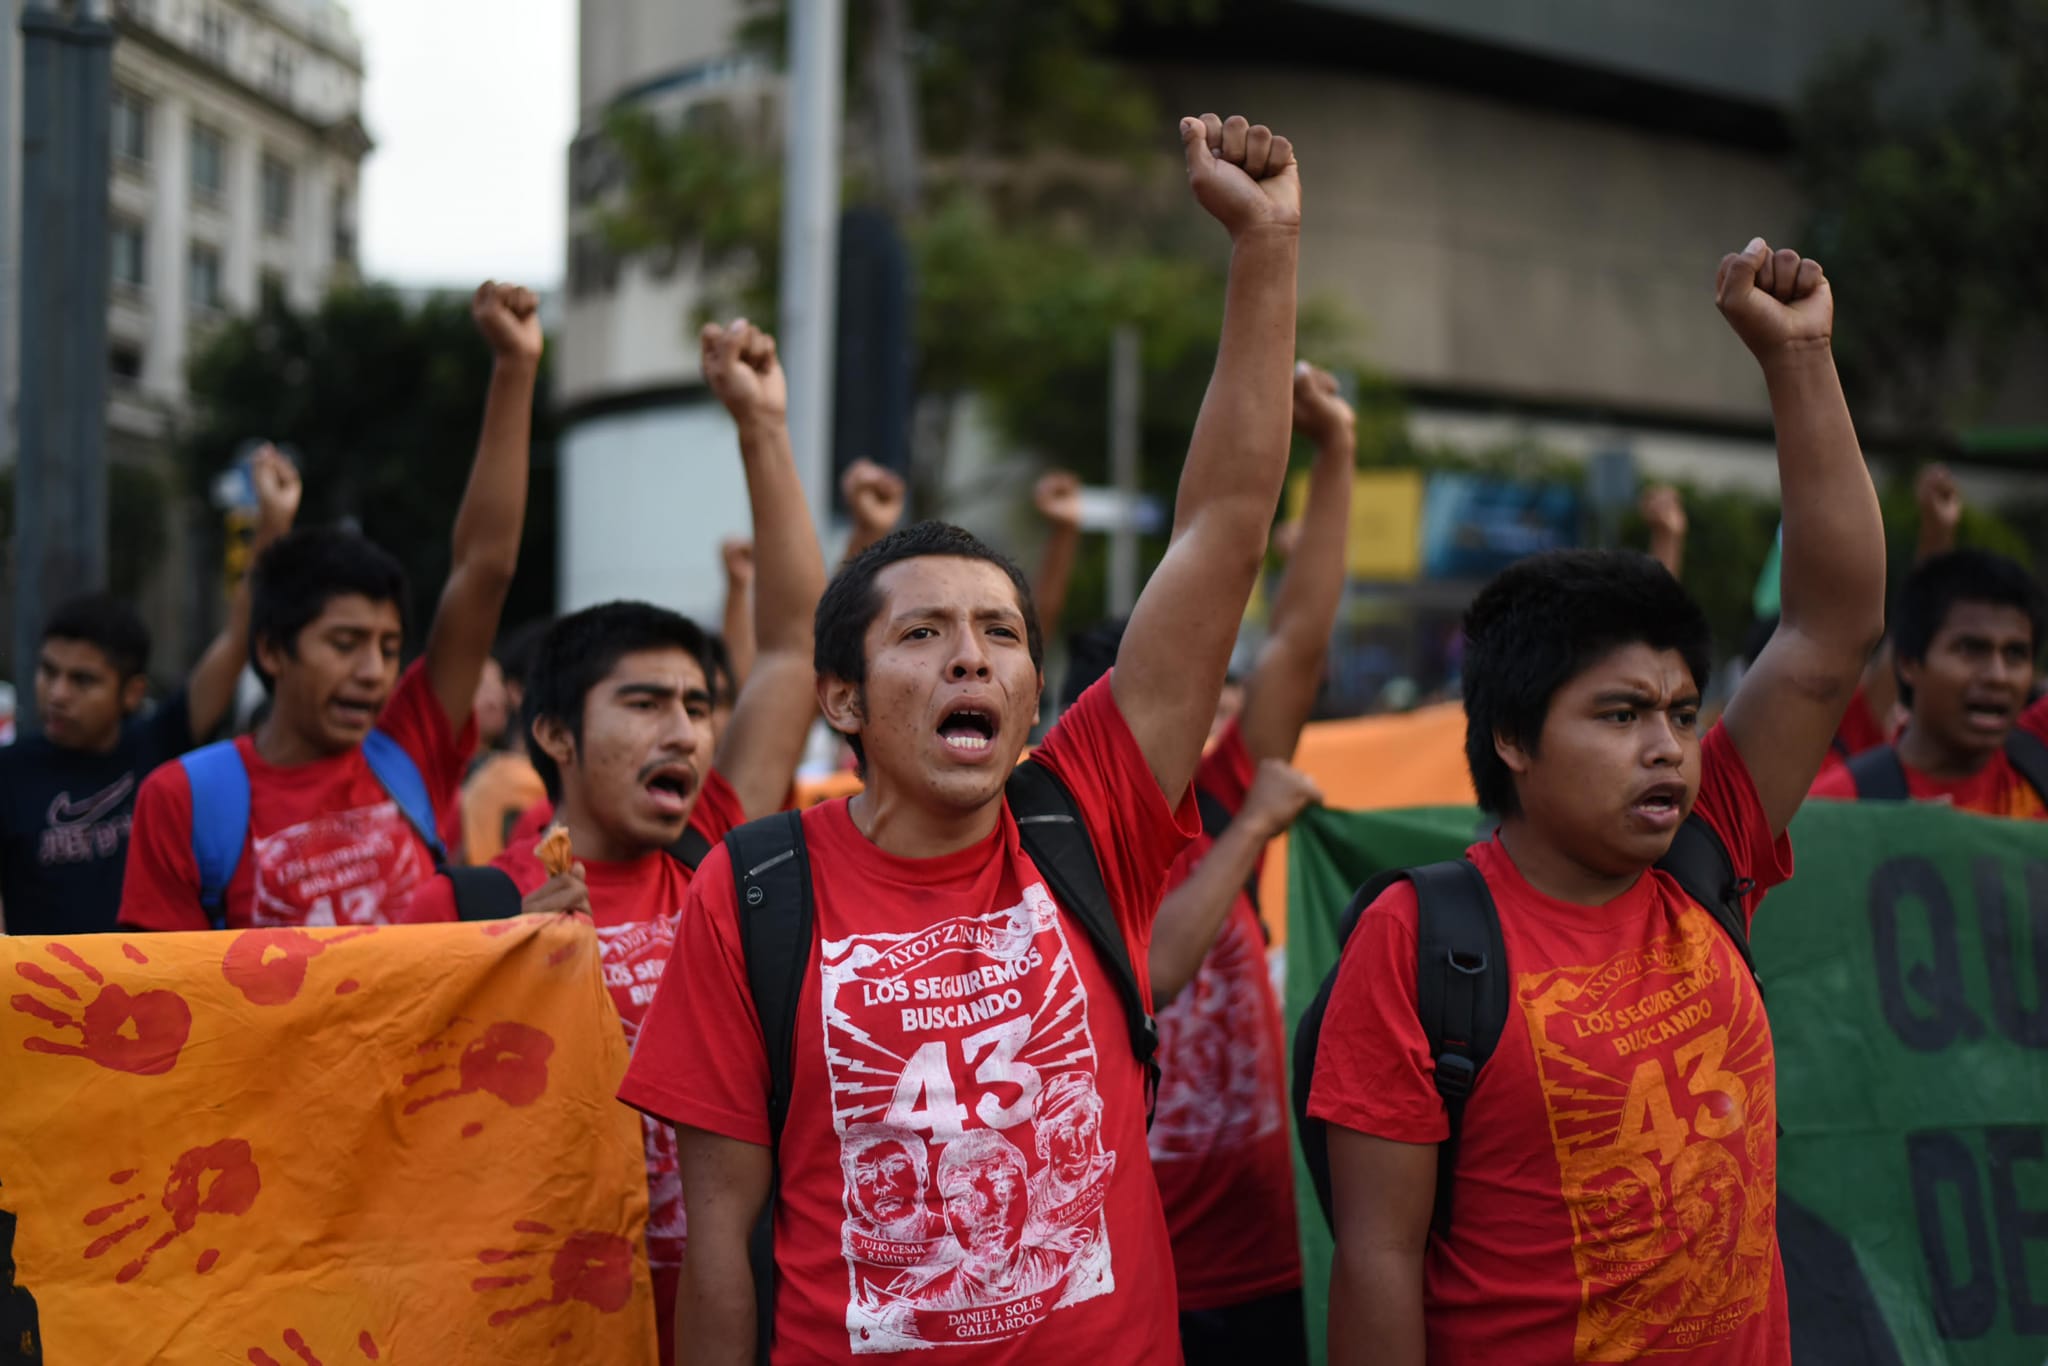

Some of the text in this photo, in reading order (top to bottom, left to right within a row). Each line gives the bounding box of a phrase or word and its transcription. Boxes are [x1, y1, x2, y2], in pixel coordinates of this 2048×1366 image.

[885, 922, 999, 970] AYOTZINAPA
[863, 946, 1043, 1006] LOS SEGUIREMOS
[901, 988, 1022, 1032] BUSCANDO
[1572, 1010, 1614, 1038] LOS
[1612, 998, 1712, 1056] BUSCANDO
[884, 1013, 1042, 1145] 43
[1613, 1024, 1748, 1165] 43
[857, 1239, 926, 1254] JULIO CESAR
[867, 1250, 921, 1265] RAMIREZ
[948, 1308, 1001, 1326] DANIEL
[956, 1313, 1035, 1338] GALLARDO
